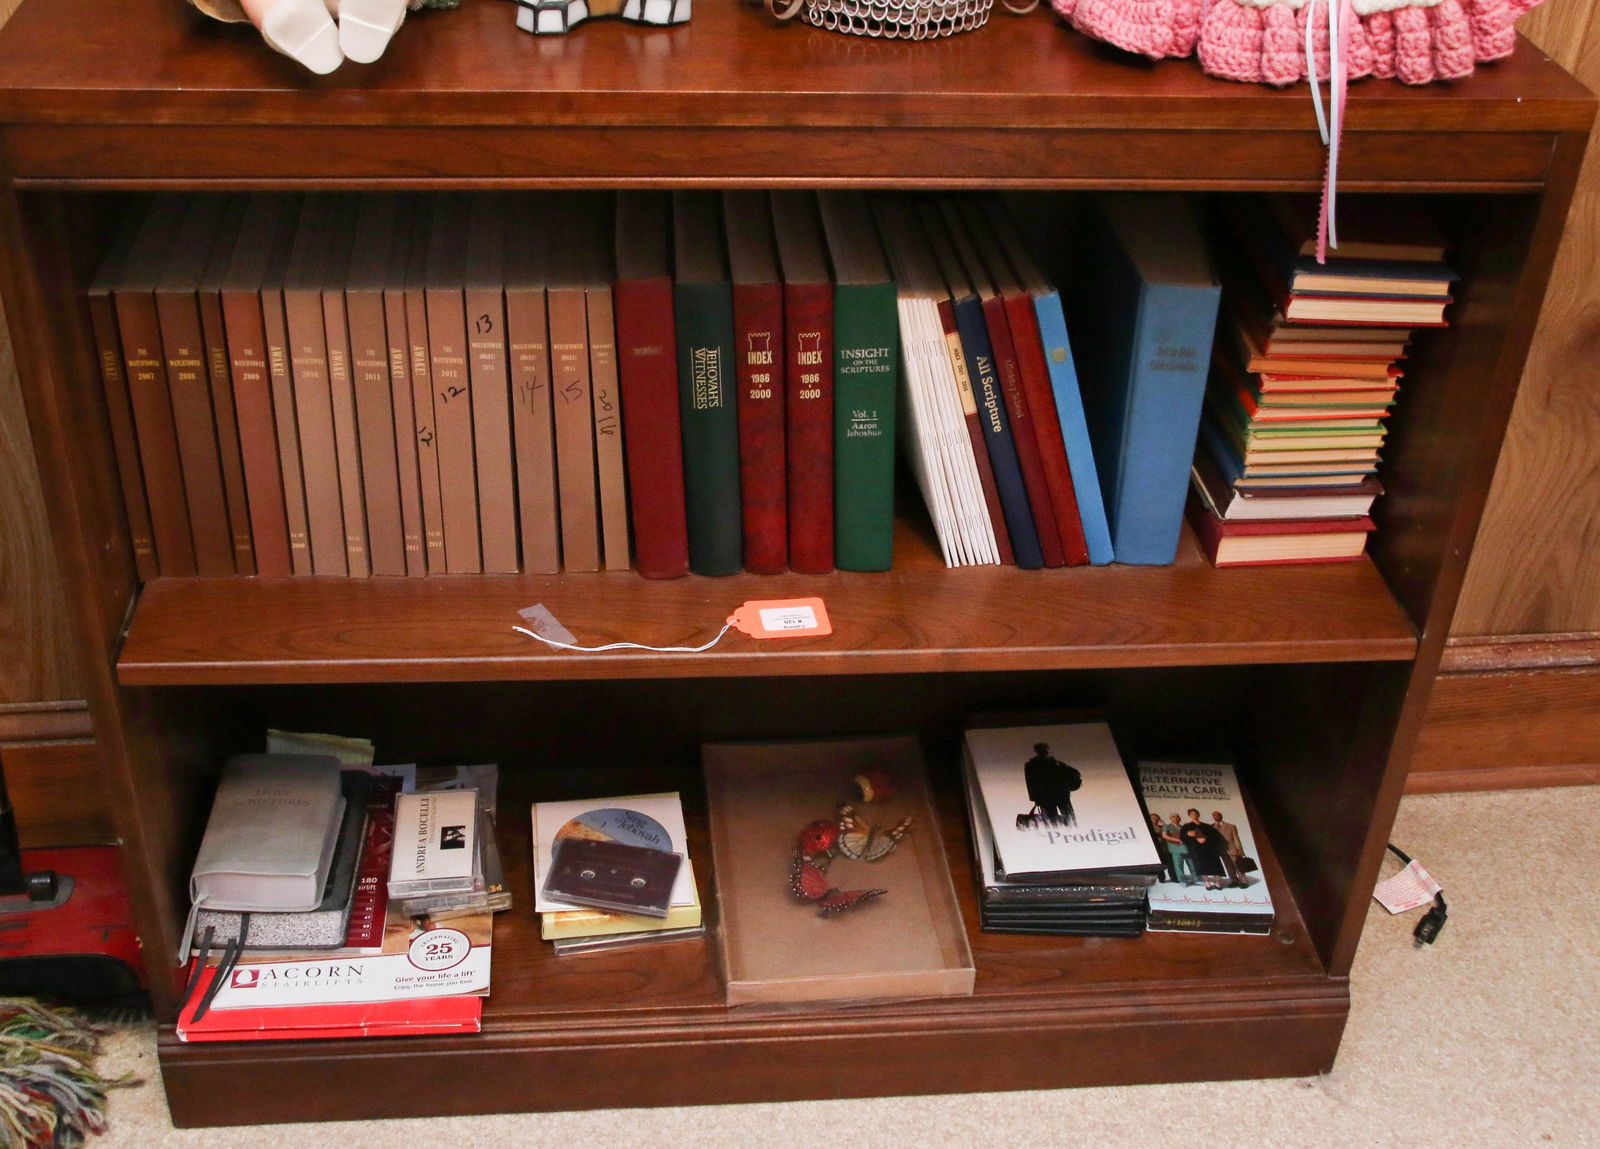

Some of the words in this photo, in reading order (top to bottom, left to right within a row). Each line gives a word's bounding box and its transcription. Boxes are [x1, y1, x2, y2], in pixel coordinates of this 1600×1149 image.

[476, 314, 492, 334] 13
[748, 350, 772, 364] INDEX
[798, 350, 822, 364] INDEX
[840, 348, 890, 359] INSIGHT
[270, 346, 284, 376] AWAKE!
[392, 348, 404, 379] AWAKE!
[413, 346, 426, 376] AWAKE!
[441, 370, 458, 378] 2012
[840, 365, 890, 374] SCRIPTURES
[694, 347, 708, 410] WITNESSES
[706, 348, 720, 408] JEHOVAH'S
[750, 373, 770, 383] 1986
[800, 373, 820, 384] 1986
[440, 386, 466, 404] 12
[520, 376, 544, 414] 14
[560, 380, 584, 406] 15
[750, 389, 771, 398] 2000
[800, 389, 820, 398] 2000
[976, 356, 988, 376] All
[982, 376, 1002, 433] Scripture
[852, 410, 870, 418] Vol.
[872, 410, 877, 418] 1
[852, 422, 877, 430] Aaron
[1142, 776, 1222, 786] ALTERNATIVE
[1142, 784, 1188, 793] HEALTH
[1192, 786, 1226, 795] CARE
[418, 798, 430, 835] BOCELLI
[1046, 827, 1136, 845] Prodigal
[416, 837, 427, 875] ANDREA
[426, 942, 452, 955] 25
[264, 965, 364, 980] ACORN
